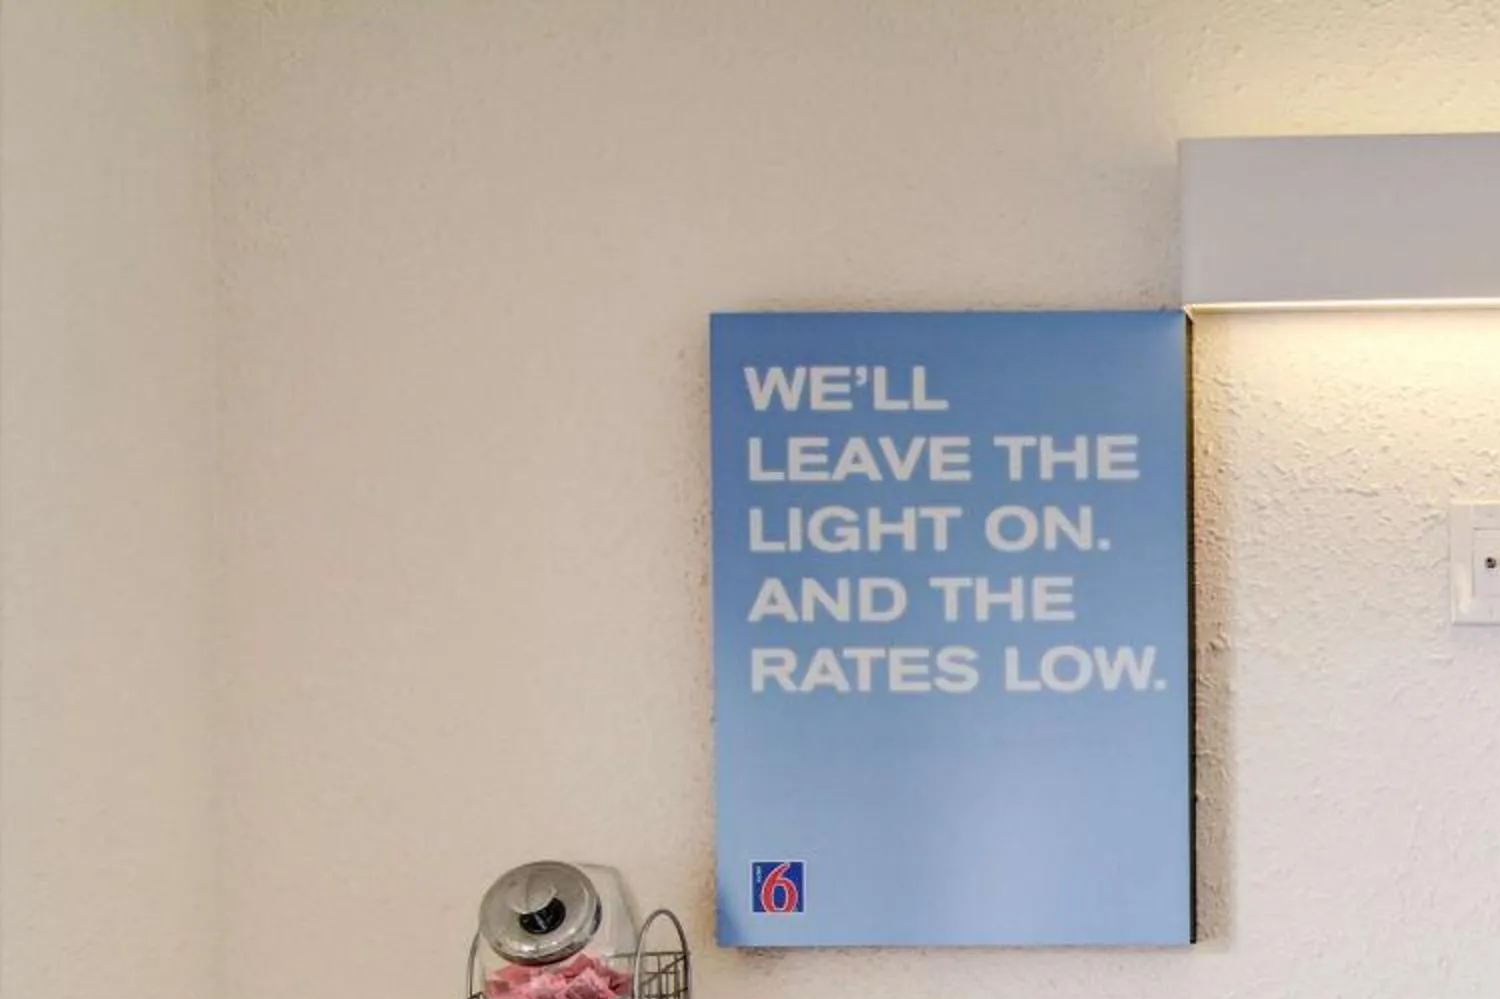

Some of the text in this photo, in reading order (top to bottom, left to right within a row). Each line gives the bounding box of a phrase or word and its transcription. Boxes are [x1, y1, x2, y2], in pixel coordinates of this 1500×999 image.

[744, 366, 949, 411] WE'LL
[749, 434, 1140, 482] LEAVE THE
[749, 505, 1111, 551] LIGHT ON.
[747, 576, 1076, 622] AND THE
[751, 646, 1167, 692] RATES LOW.
[761, 862, 798, 912] 6
